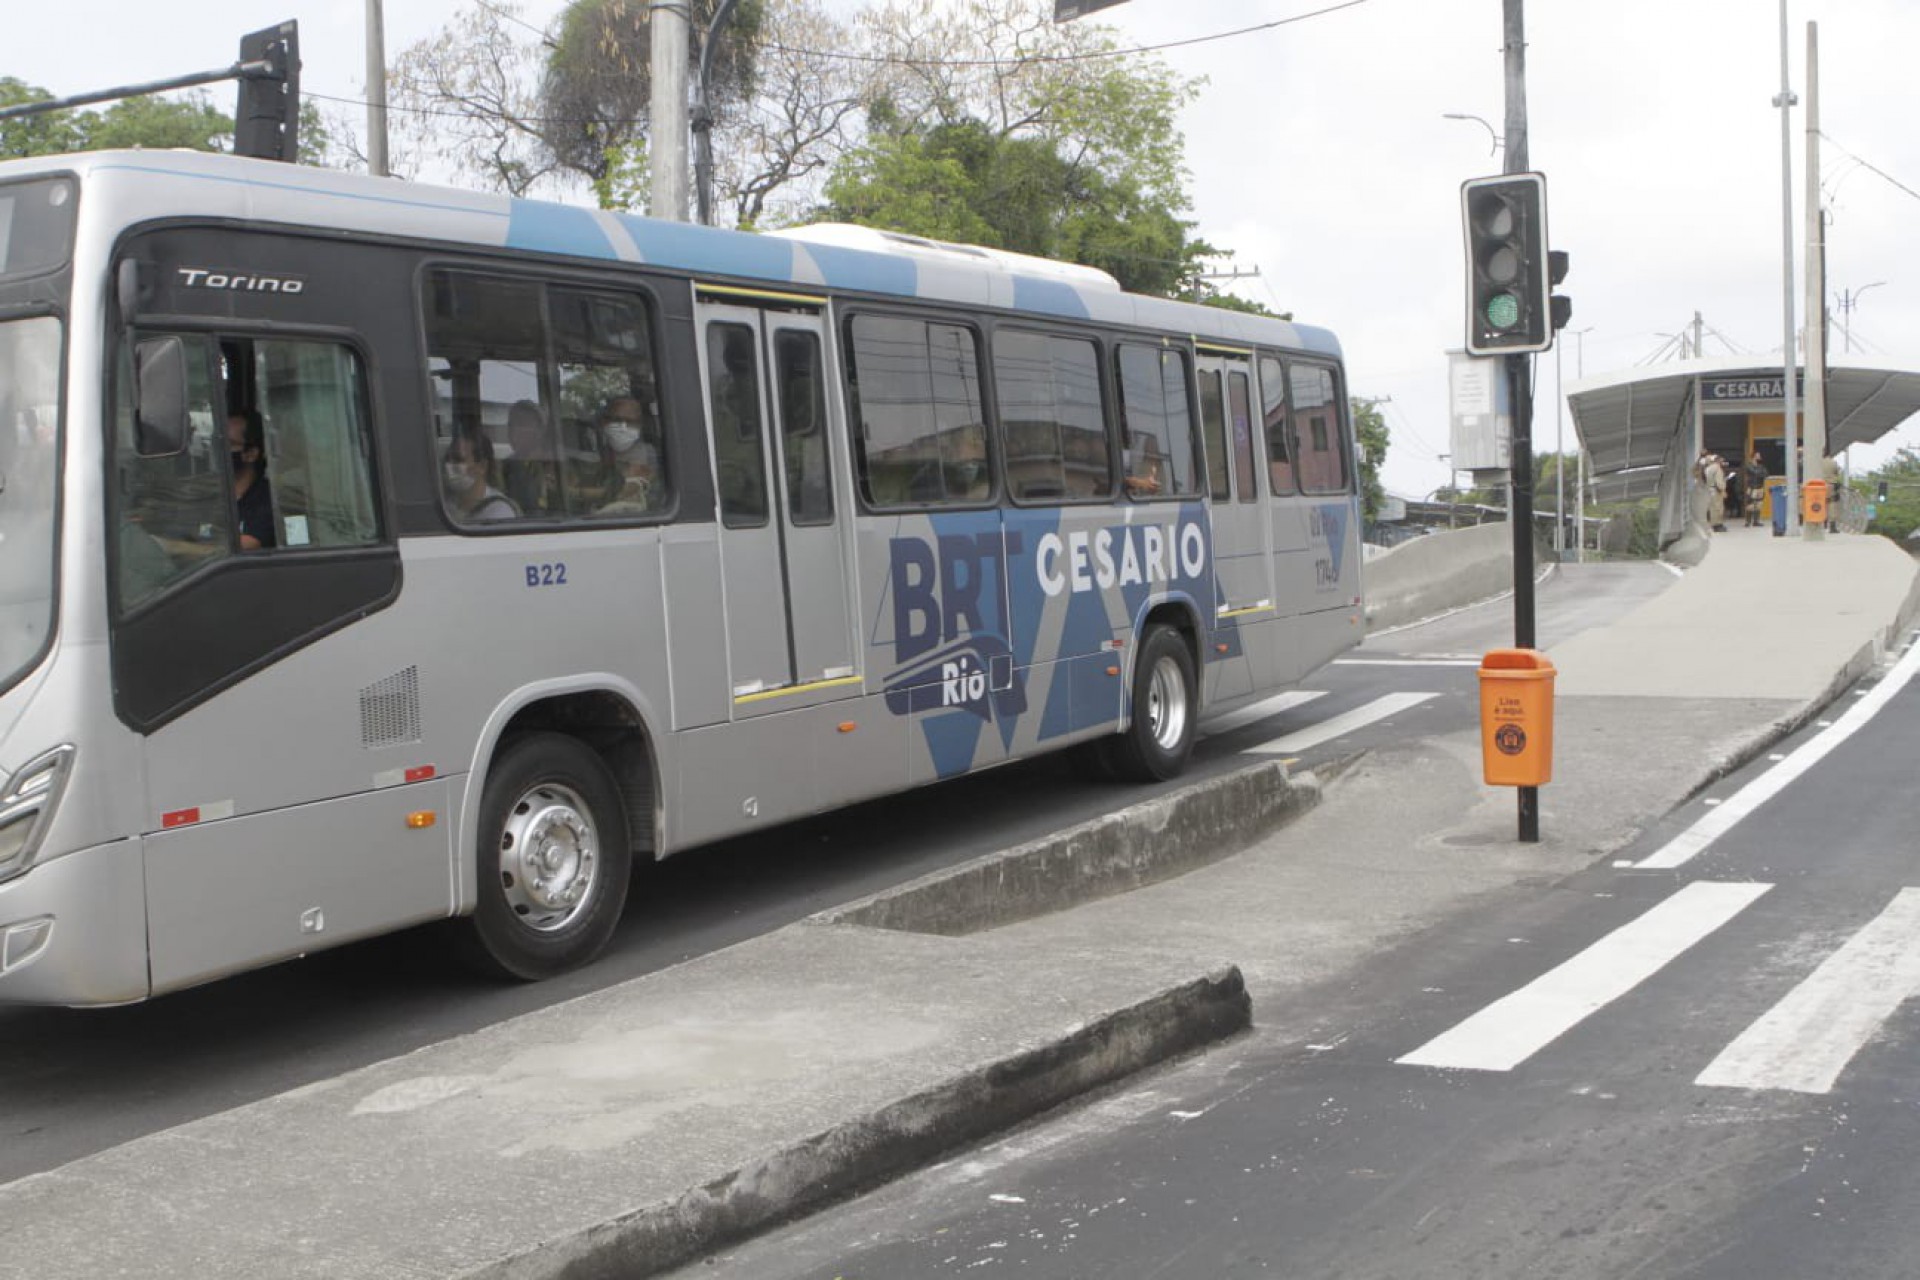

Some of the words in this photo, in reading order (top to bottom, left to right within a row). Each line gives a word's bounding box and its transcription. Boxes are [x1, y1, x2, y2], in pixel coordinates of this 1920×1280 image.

[178, 267, 303, 293] Torino
[1713, 379, 1786, 398] CESARÃ
[1036, 506, 1204, 597] CESÁRIO
[525, 562, 567, 587] B22
[889, 531, 1023, 664] BRT
[941, 657, 985, 706] Rio
